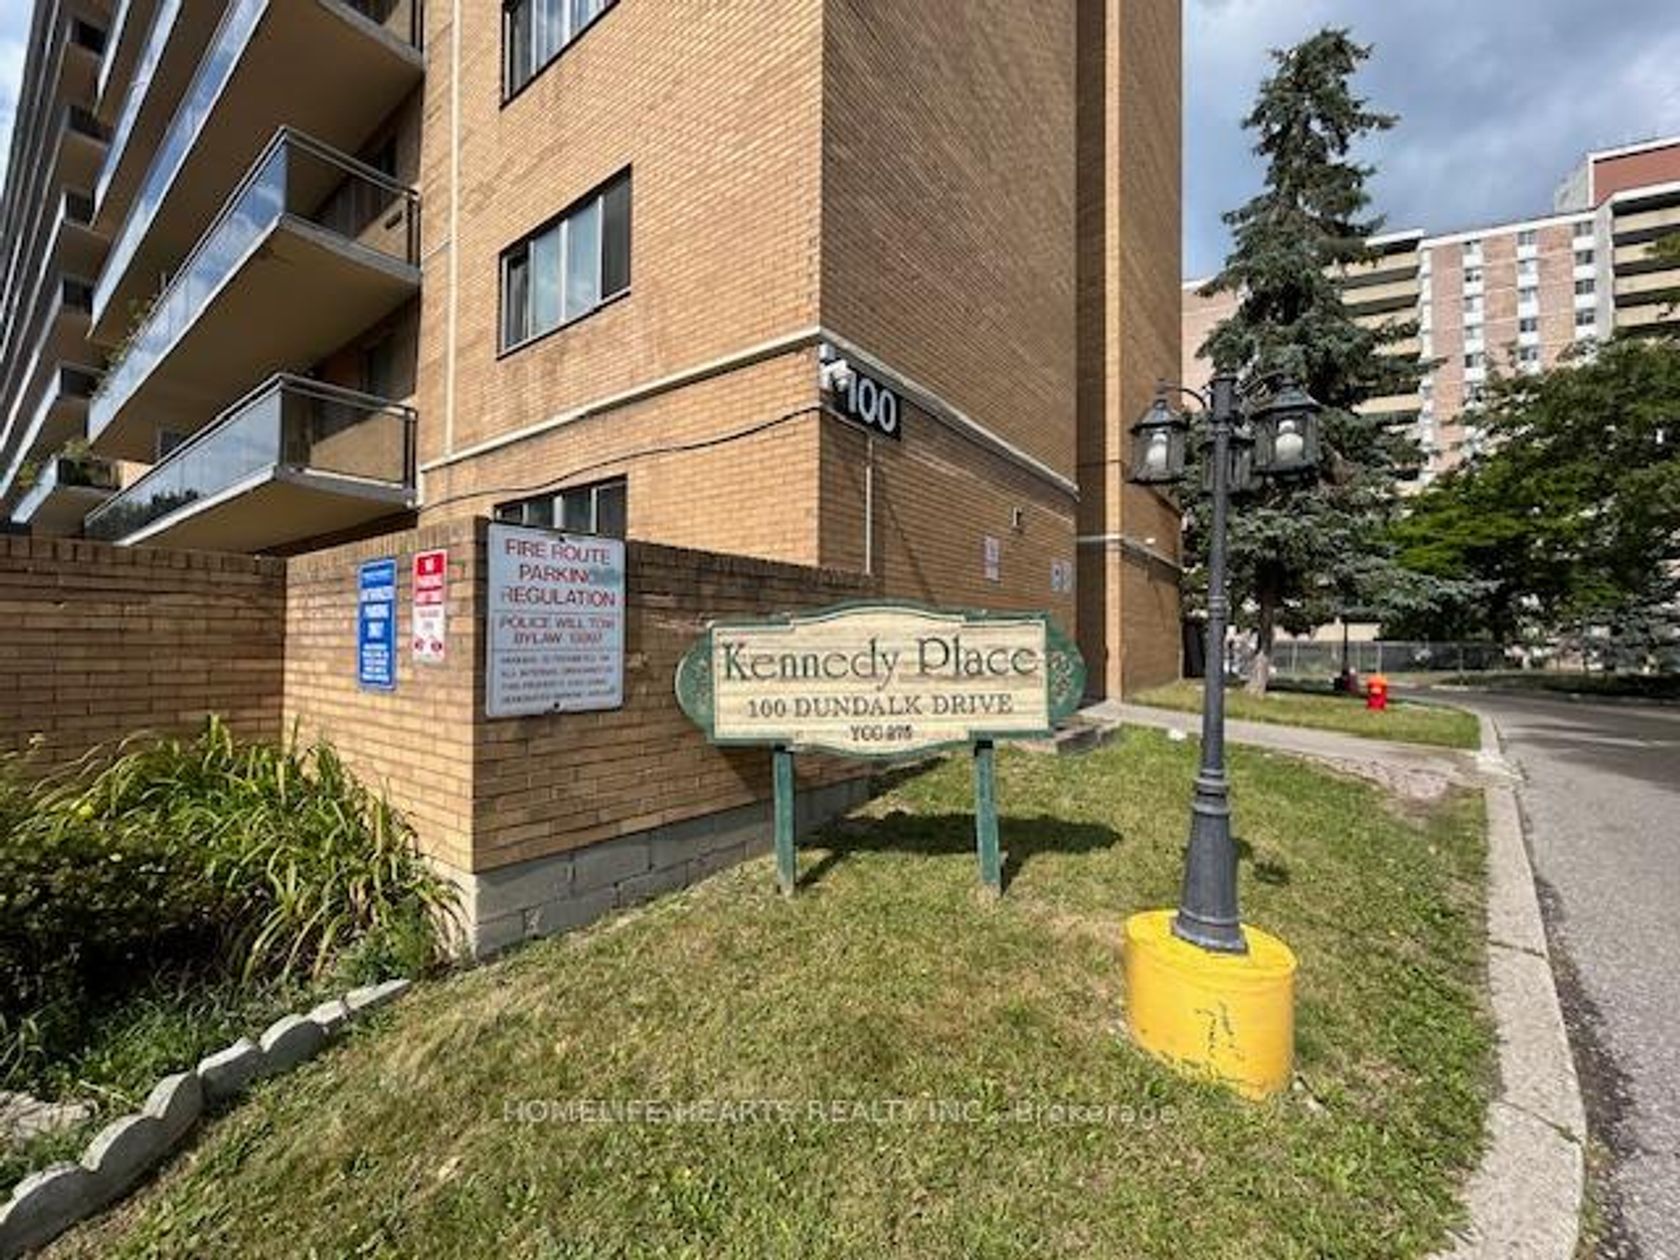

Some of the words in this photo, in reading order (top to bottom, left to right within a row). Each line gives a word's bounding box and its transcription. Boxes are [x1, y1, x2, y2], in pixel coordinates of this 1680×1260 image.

[846, 371, 897, 433] 100
[505, 538, 547, 558] FIRE
[552, 543, 610, 565] ROUTE
[502, 585, 616, 607] REGULATION
[499, 616, 548, 629] POLICE
[722, 638, 899, 691] Kennedy
[915, 634, 1039, 677] Place
[748, 699, 787, 718] 100
[794, 695, 922, 717] DUNDALK
[931, 694, 1014, 714] DRIVE
